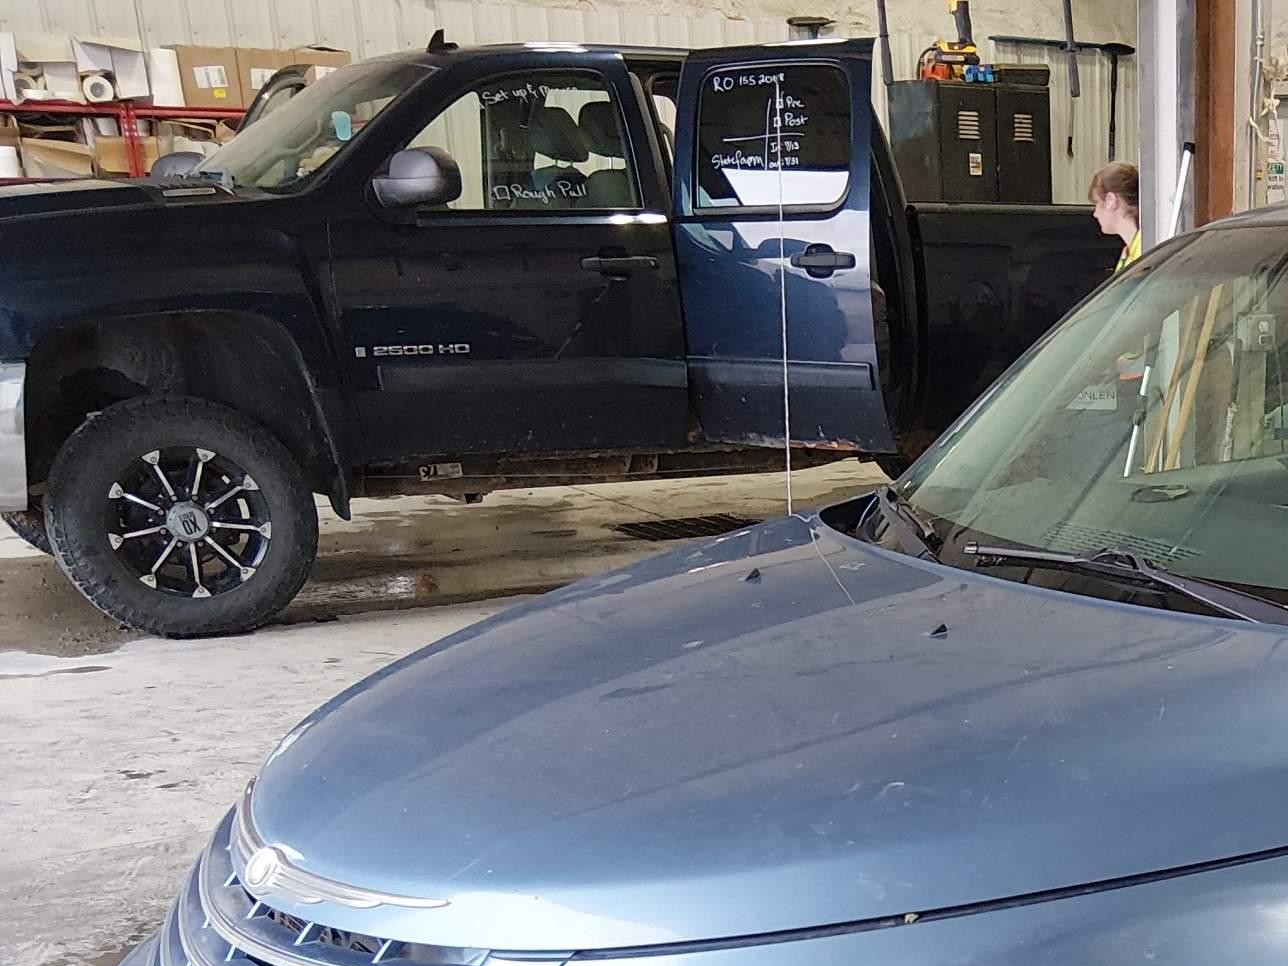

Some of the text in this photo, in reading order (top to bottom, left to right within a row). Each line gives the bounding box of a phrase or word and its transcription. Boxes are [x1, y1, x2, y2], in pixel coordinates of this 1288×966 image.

[713, 76, 734, 92] RO
[481, 89, 509, 104] Set
[511, 88, 528, 104] up
[784, 112, 809, 127] Post
[510, 180, 588, 204] Rough Pull
[373, 343, 471, 356] 2500 HD
